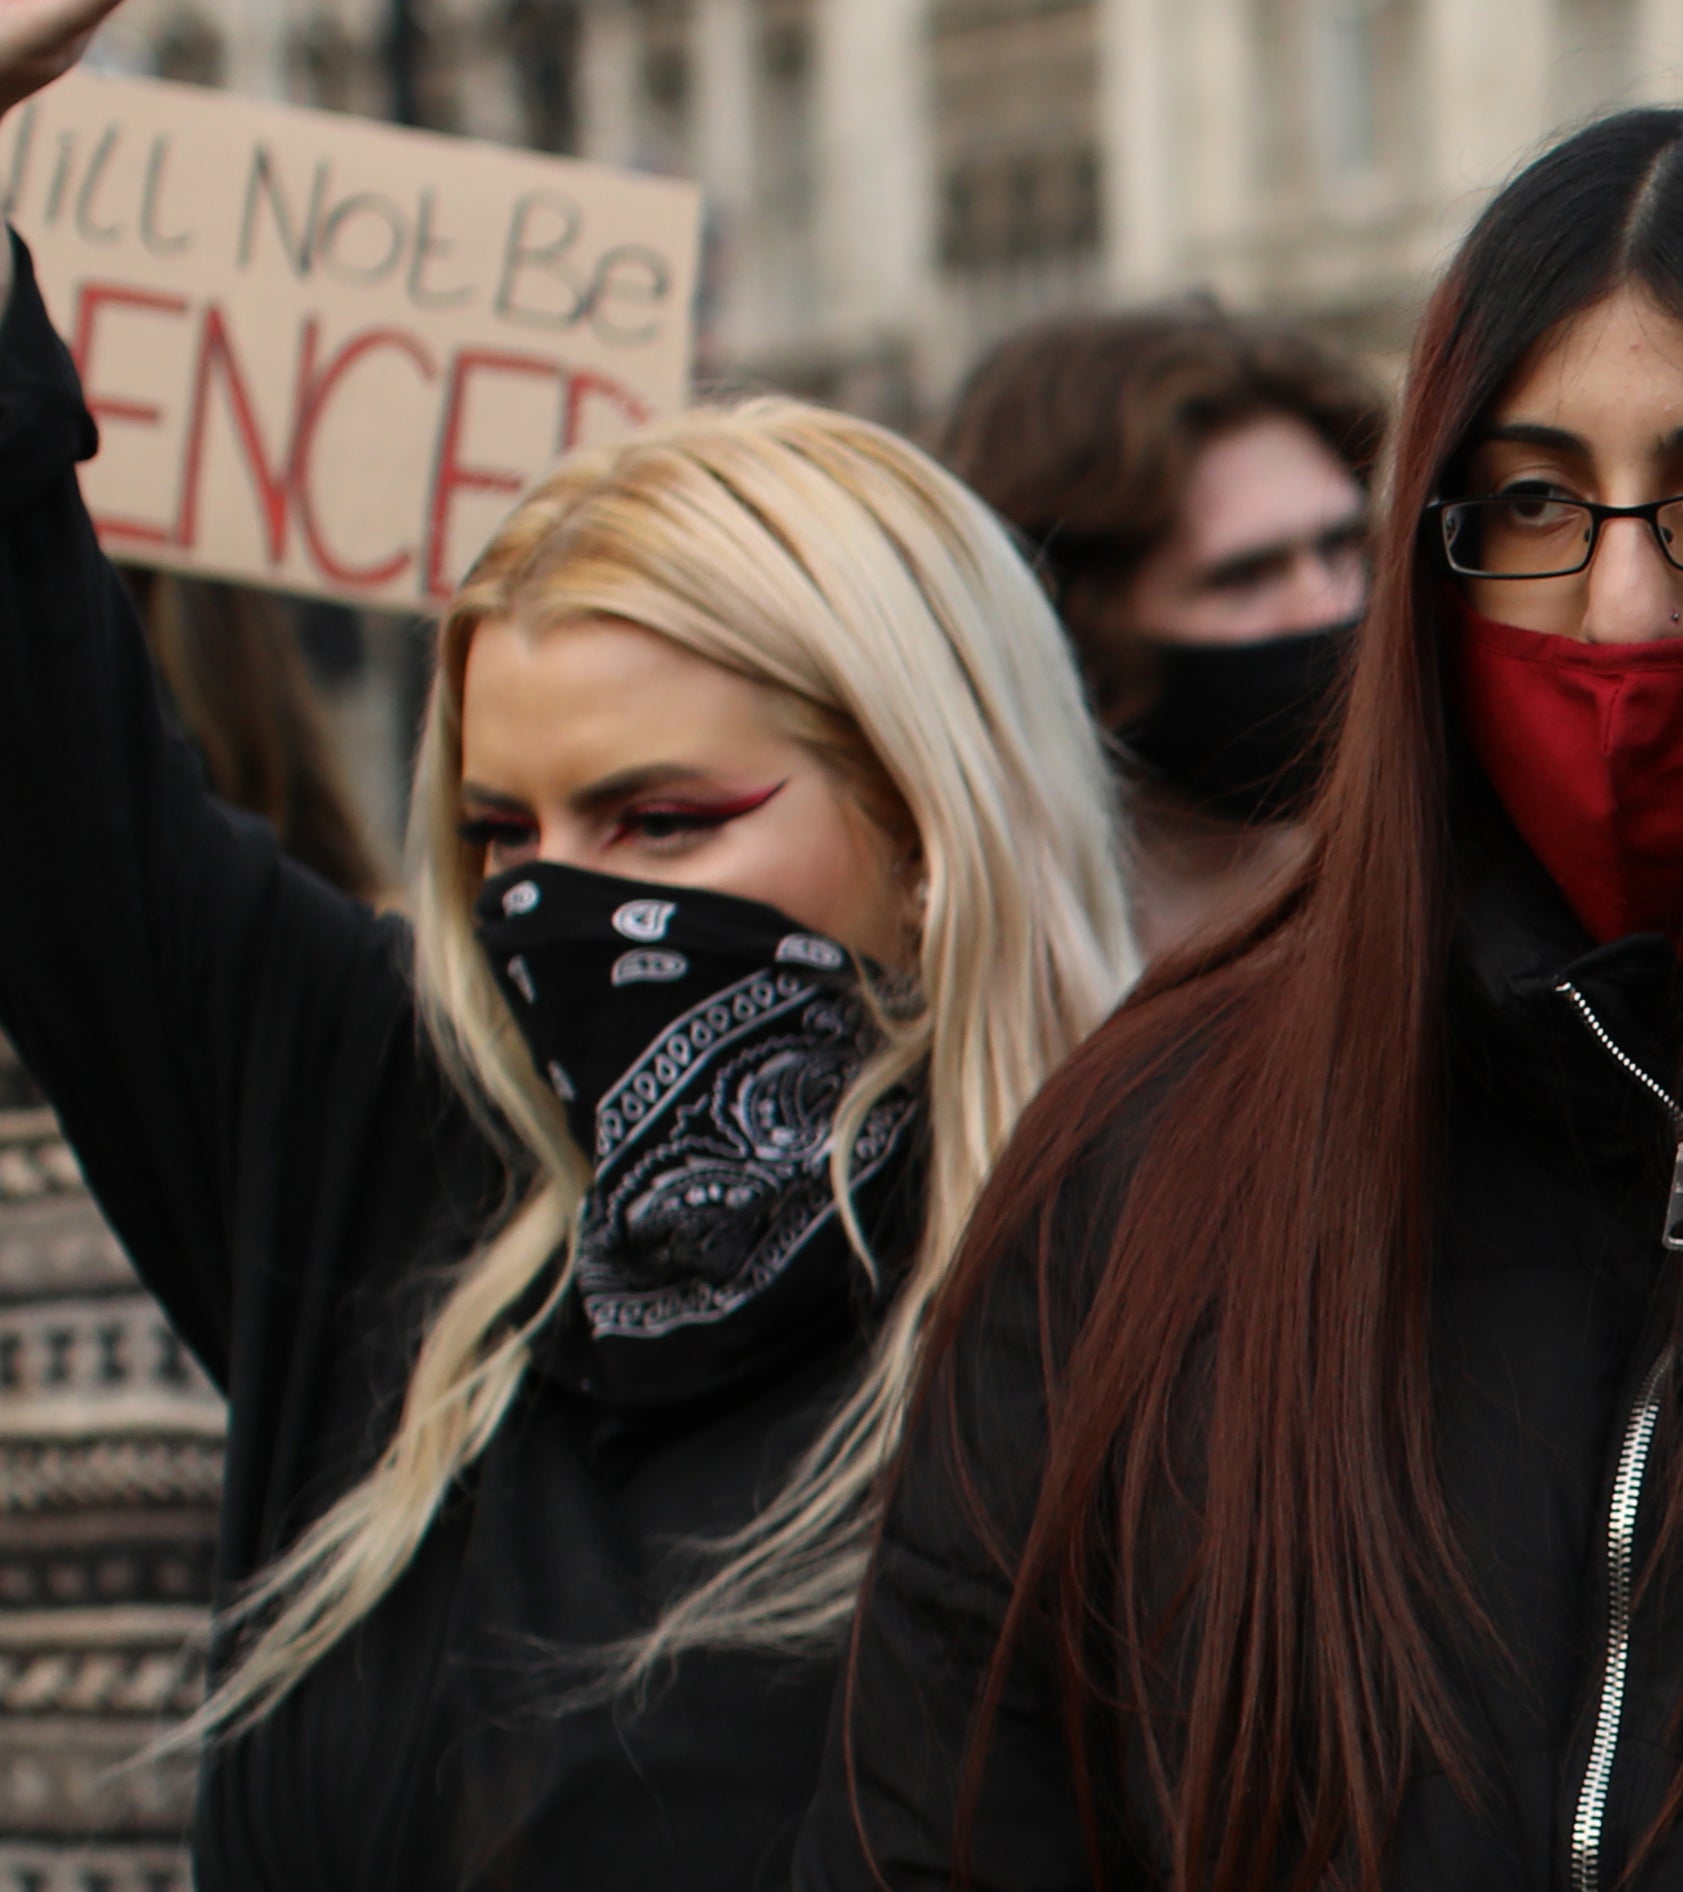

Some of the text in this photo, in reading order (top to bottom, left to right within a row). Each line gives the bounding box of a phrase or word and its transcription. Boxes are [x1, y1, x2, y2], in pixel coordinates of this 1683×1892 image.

[236, 142, 478, 312] Not
[496, 187, 673, 348] Be
[71, 284, 650, 605] ENCE
